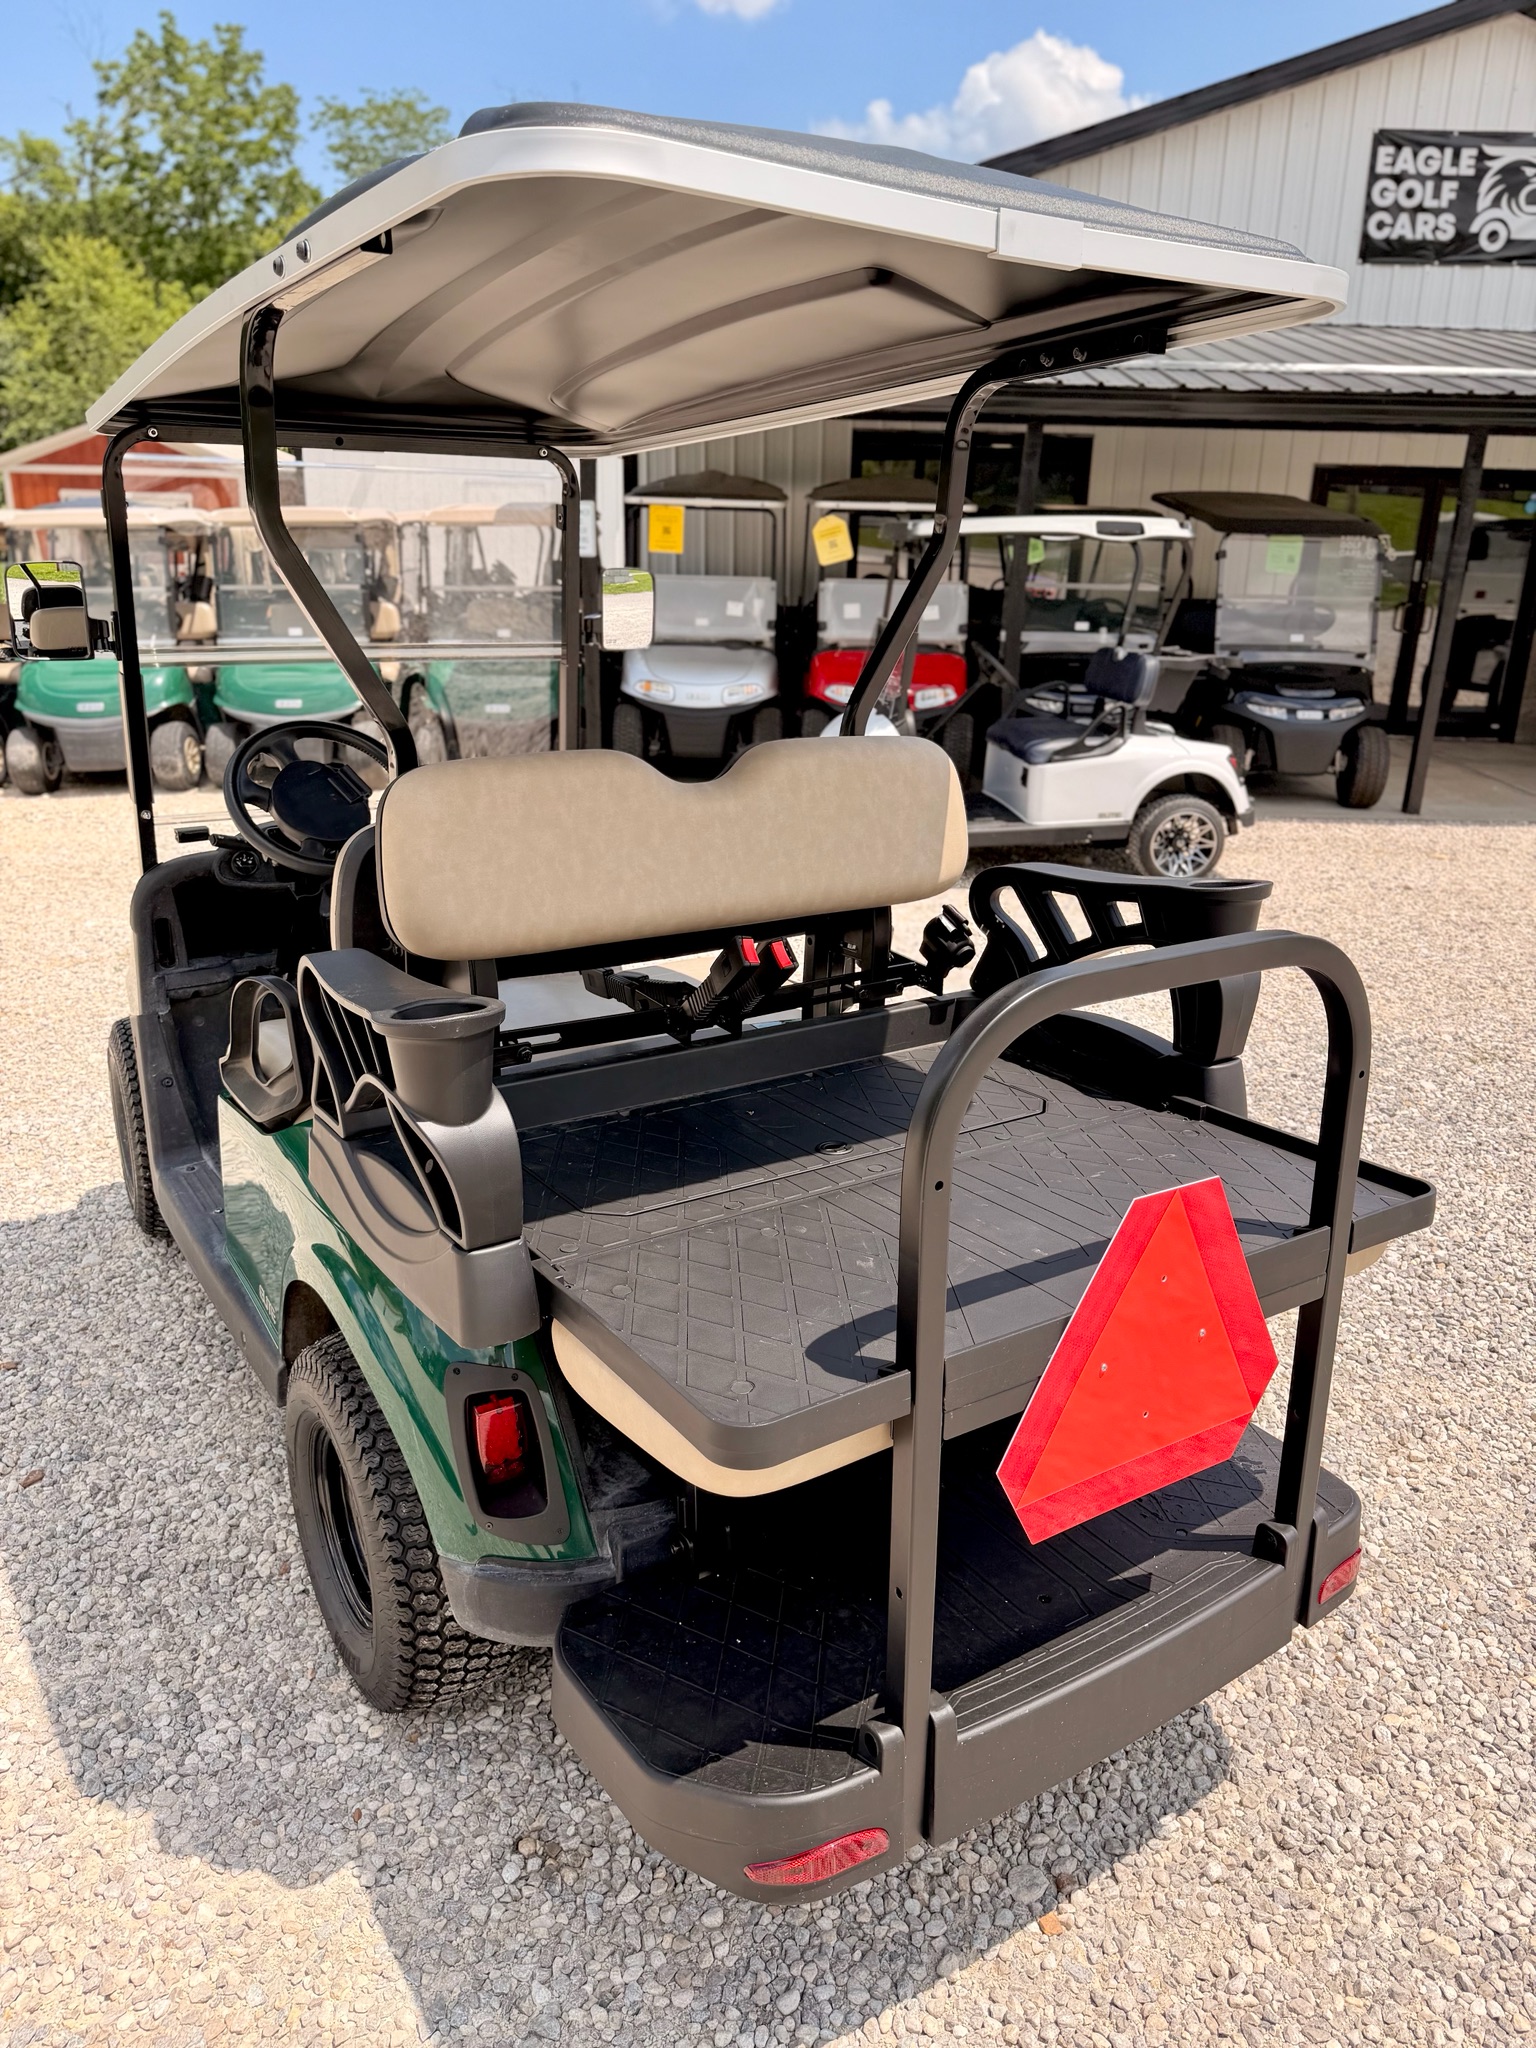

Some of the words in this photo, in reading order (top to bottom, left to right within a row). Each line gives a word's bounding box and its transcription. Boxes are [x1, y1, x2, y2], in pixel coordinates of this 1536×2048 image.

[1375, 145, 1479, 176] EAGLE
[1370, 178, 1459, 209] GOLF
[1366, 210, 1457, 242] CARS
